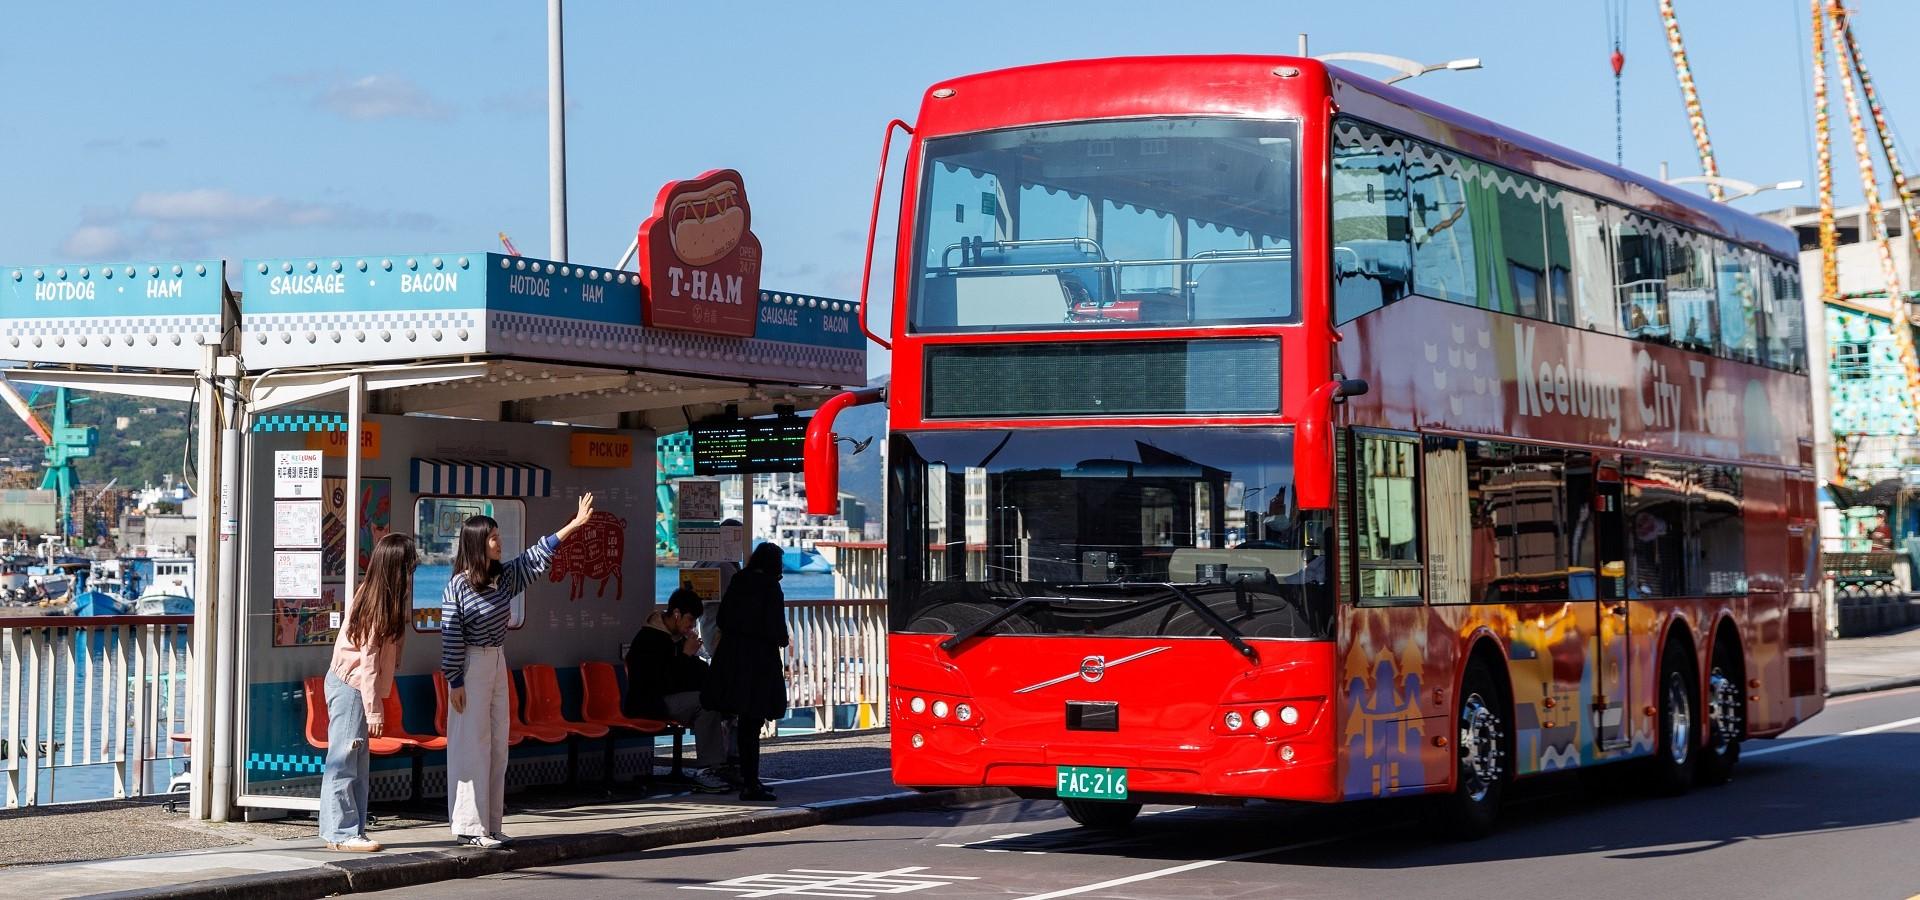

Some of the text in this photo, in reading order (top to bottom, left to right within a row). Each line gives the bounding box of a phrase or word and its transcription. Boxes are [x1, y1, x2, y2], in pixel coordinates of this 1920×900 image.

[740, 247, 757, 258] OPEN
[740, 261, 756, 273] 24/7
[35, 280, 182, 301] HOTDOG HAM
[270, 273, 457, 295] SAUSAGE BACON
[509, 275, 604, 303] HOTDOG HAM
[668, 266, 743, 305] T-HAM
[761, 307, 849, 333] SAUSAGE BACON
[1515, 325, 1737, 447] Keelung City Tour
[589, 441, 629, 458] PICK UP
[1058, 772, 1126, 795] FAC-216
